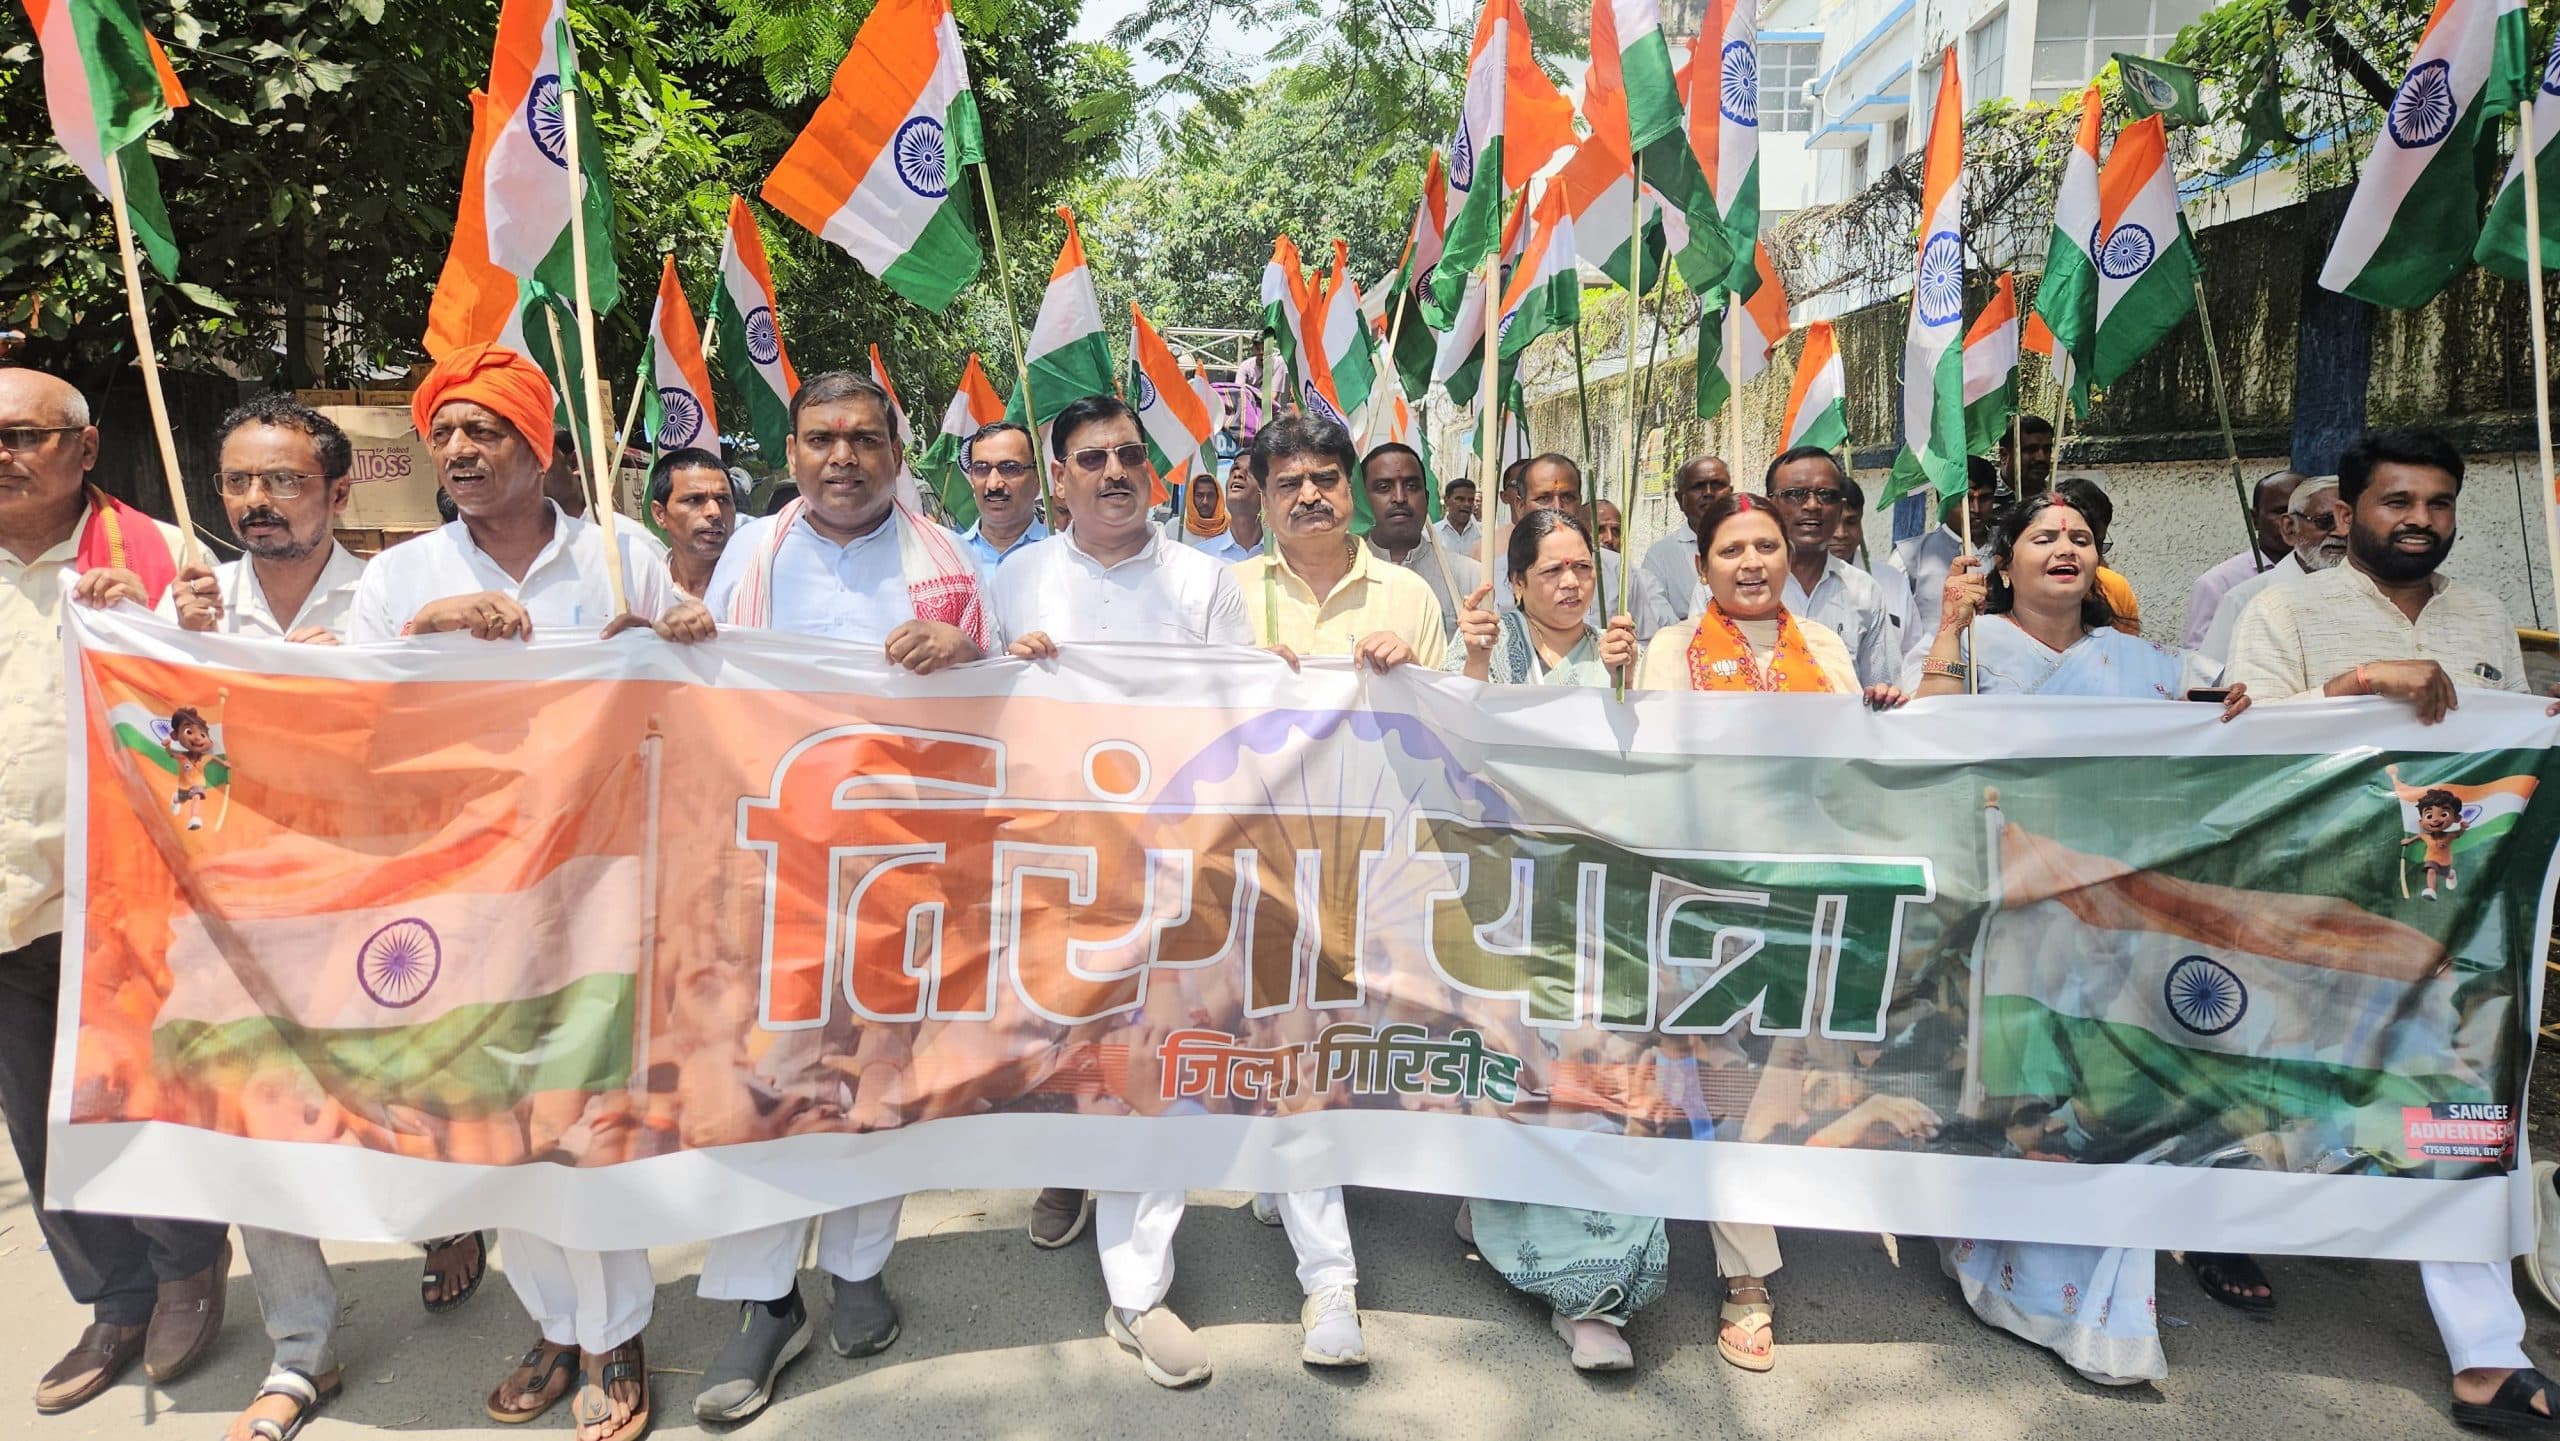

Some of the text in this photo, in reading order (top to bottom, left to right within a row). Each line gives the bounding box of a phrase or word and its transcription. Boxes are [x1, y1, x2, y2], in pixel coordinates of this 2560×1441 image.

[737, 724, 1936, 1041] तिरंगा यात्रा
[1158, 1023, 1524, 1104] जिला गिरिडीह
